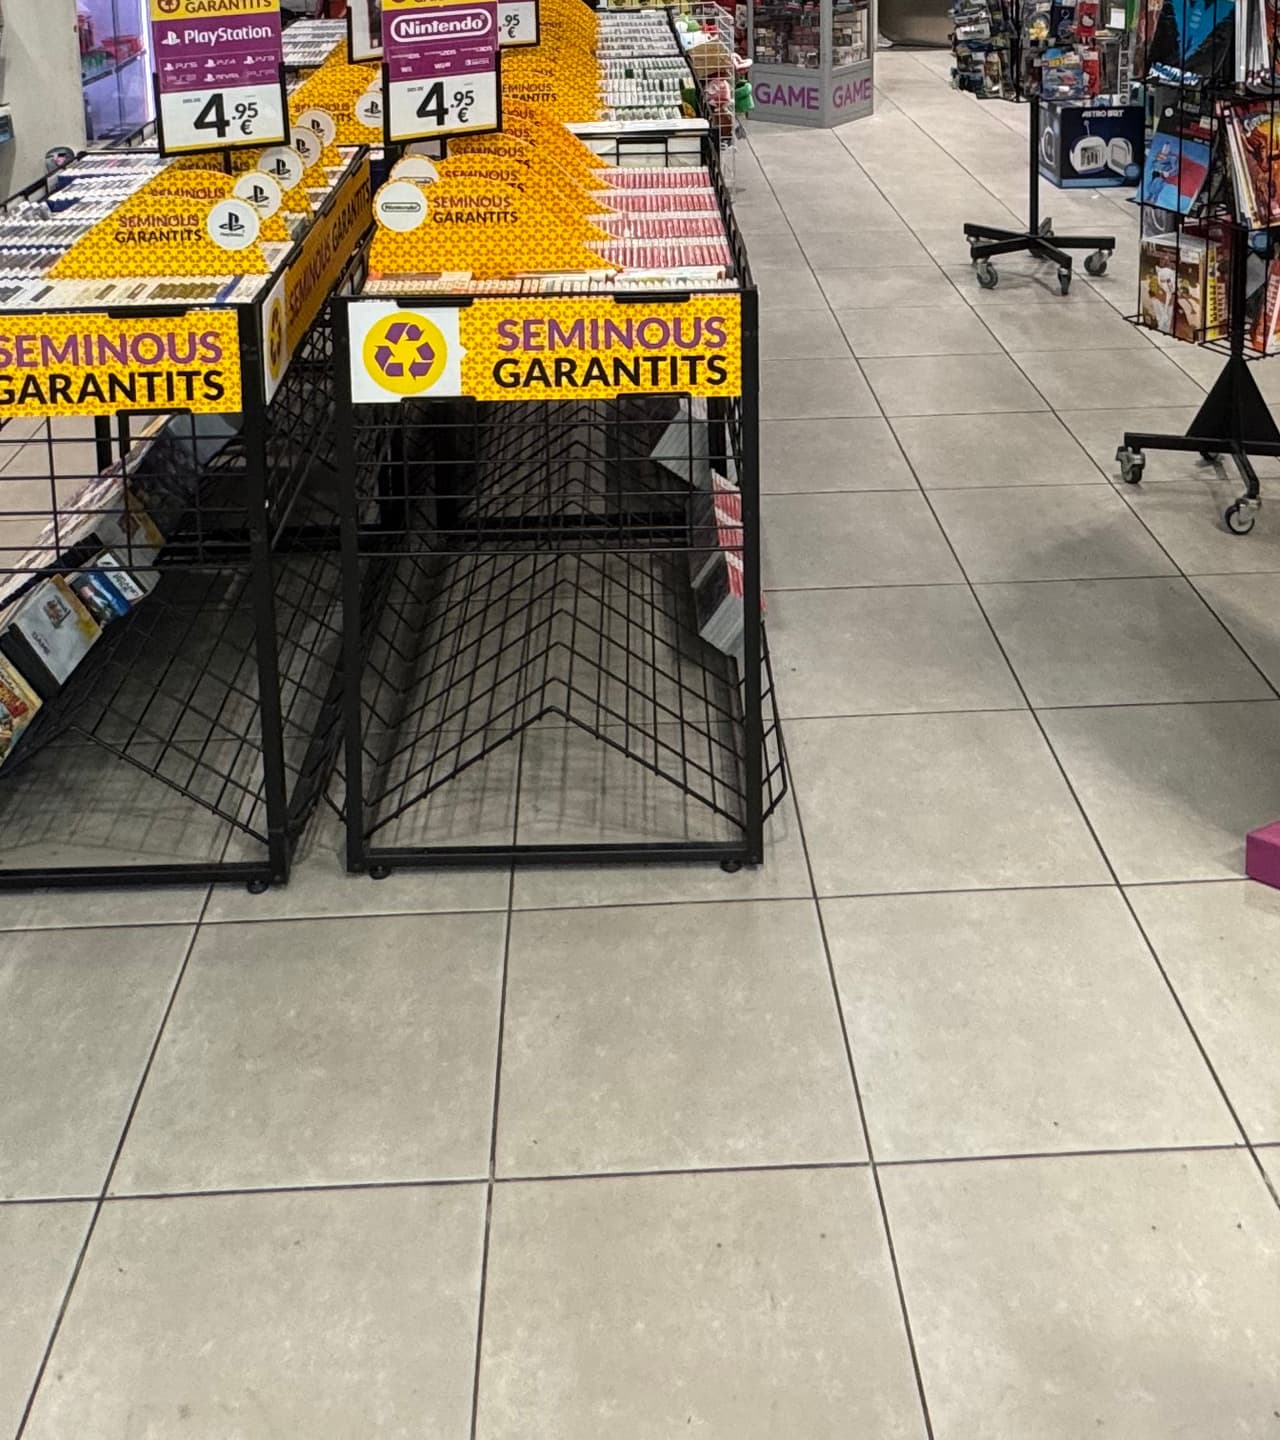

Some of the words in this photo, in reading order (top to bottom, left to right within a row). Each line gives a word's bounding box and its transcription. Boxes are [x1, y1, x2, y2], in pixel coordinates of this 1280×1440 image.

[184, 26, 272, 46] PlayStation
[400, 16, 483, 36] Nintendo
[755, 83, 820, 109] GAME
[832, 78, 870, 108] GAME
[433, 195, 511, 209] SEMINOUS
[119, 214, 199, 228] SEMINOUS
[433, 209, 518, 224] GARANTITS
[114, 229, 202, 244] GARANTITS
[497, 316, 727, 352] SEMINOUS
[493, 354, 728, 388] GARANTITS
